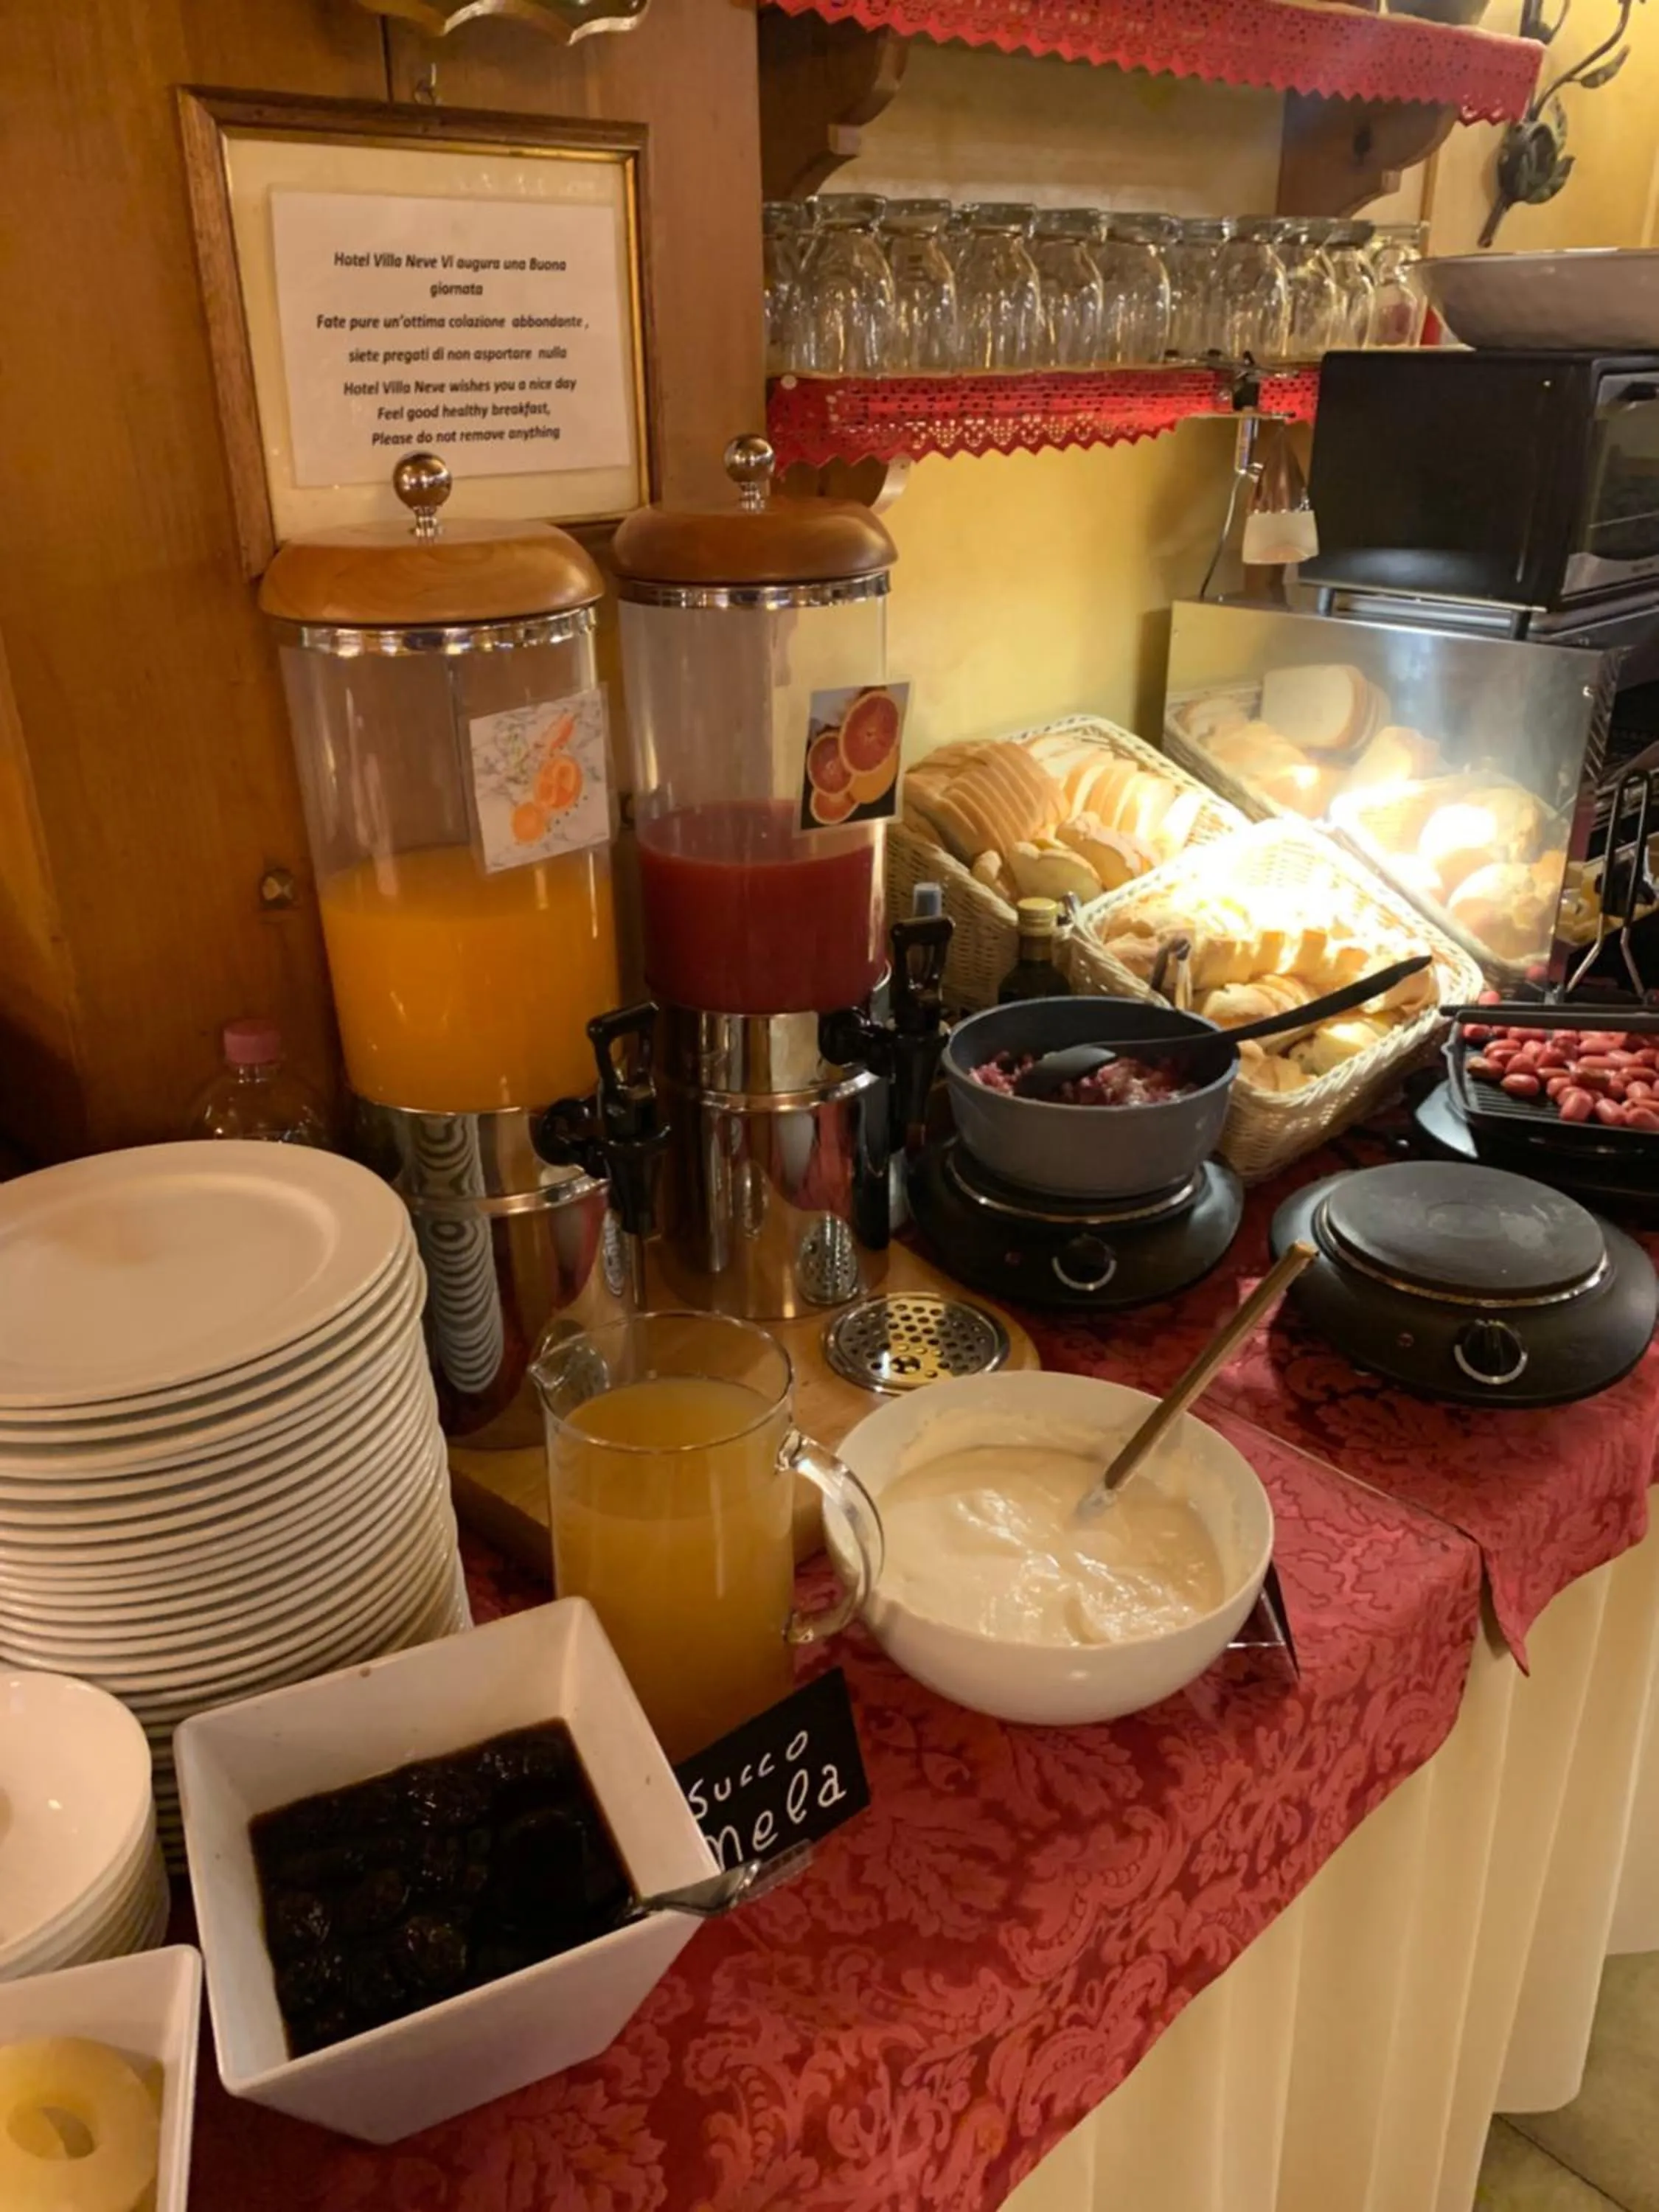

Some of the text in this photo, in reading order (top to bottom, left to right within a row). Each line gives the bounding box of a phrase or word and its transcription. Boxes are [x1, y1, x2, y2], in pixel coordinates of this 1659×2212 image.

[333, 251, 567, 274] Hotel Villa Neve Vi augura una Buona
[429, 280, 484, 299] giornata
[316, 313, 347, 330] Fate
[349, 317, 381, 332] pure
[448, 313, 507, 329] colazione
[511, 313, 583, 329] abbondante
[348, 345, 568, 366] siete pregati di non asportare nulla
[343, 377, 577, 397] Hotel Villa Neve wishes you a nice day
[377, 406, 405, 421] Feel
[406, 404, 440, 423] good
[441, 403, 490, 420] healthy
[371, 424, 561, 447] Please do not remove anything
